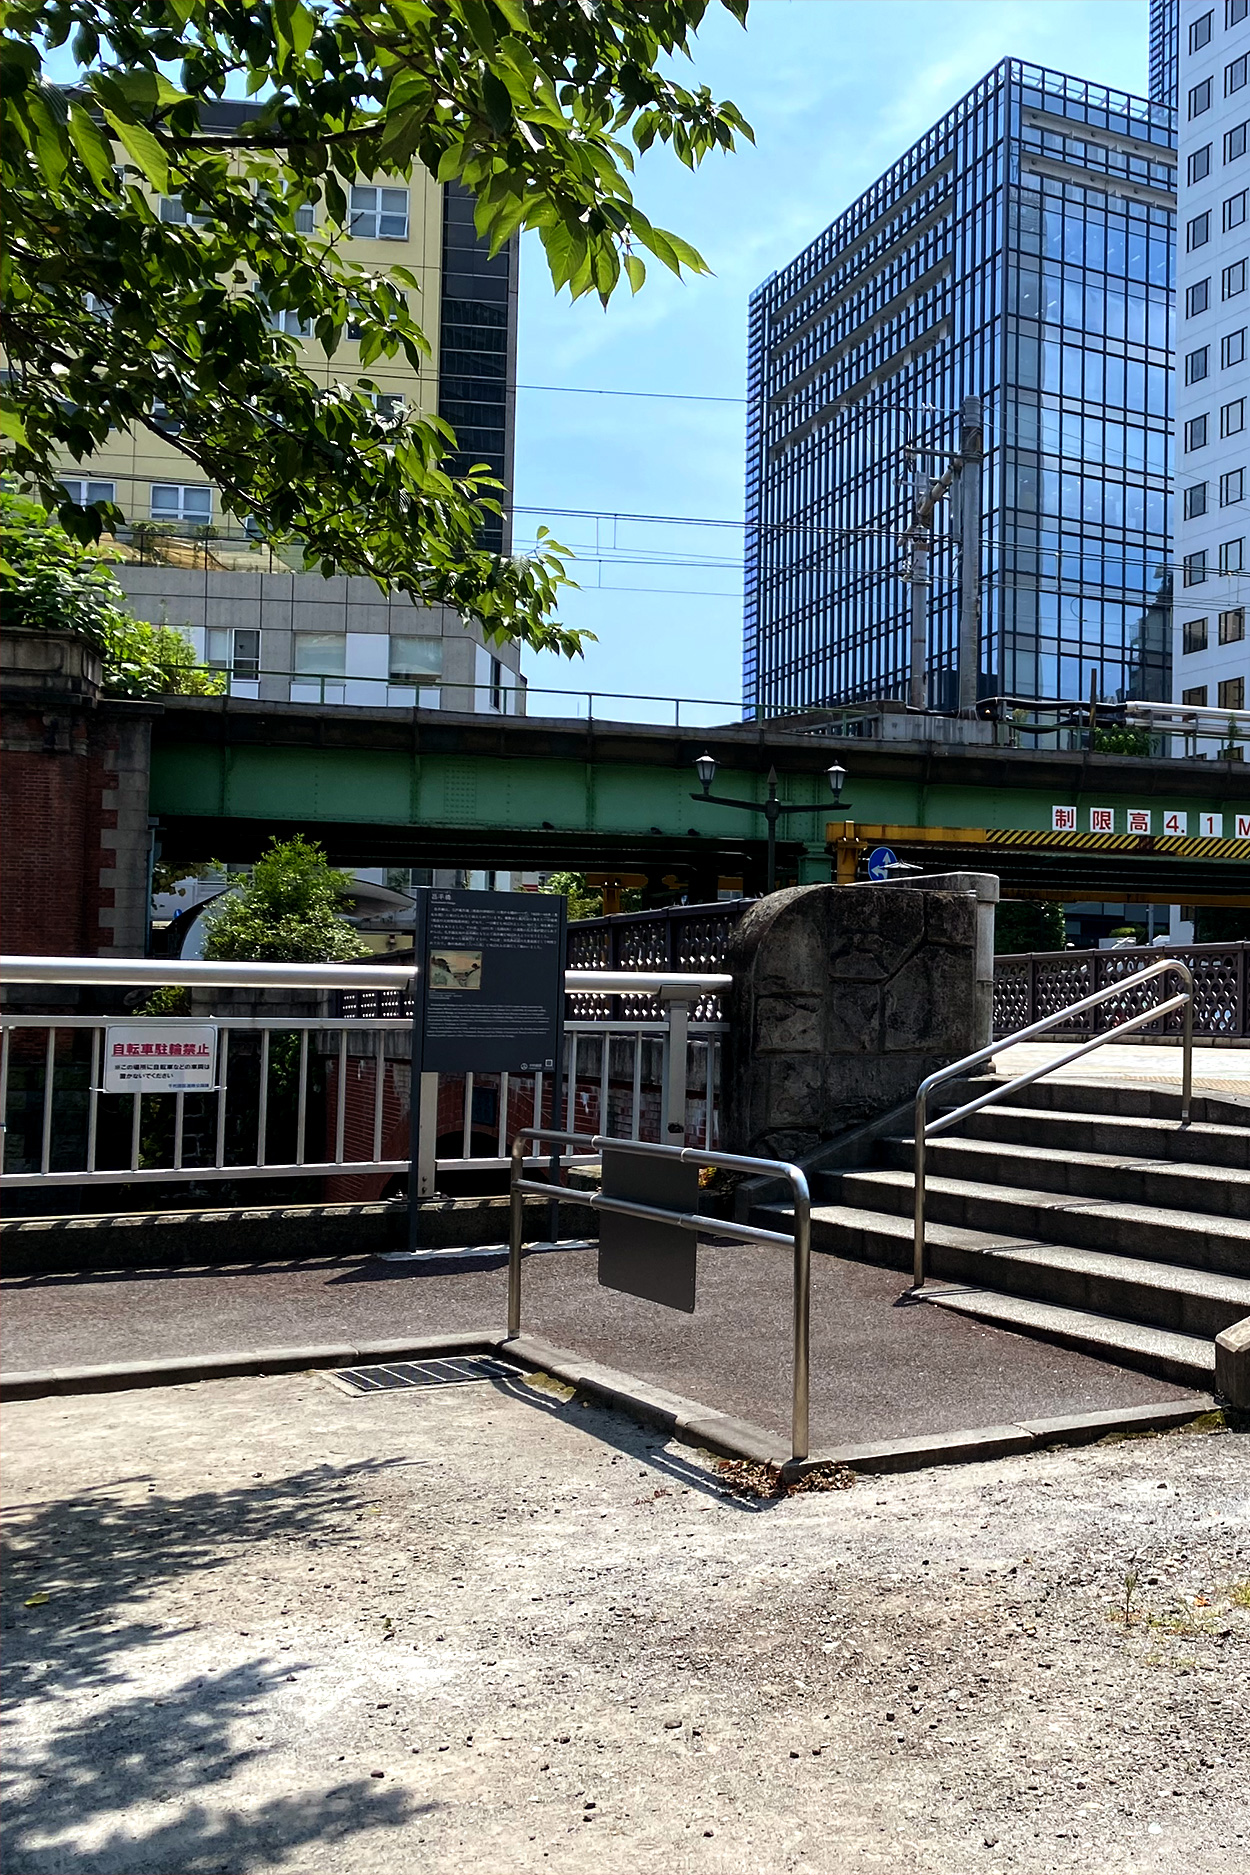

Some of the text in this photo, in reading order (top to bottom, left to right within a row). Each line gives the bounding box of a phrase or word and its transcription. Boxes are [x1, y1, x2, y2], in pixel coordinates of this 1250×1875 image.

[113, 1043, 210, 1056] 自転車駐輪禁止
